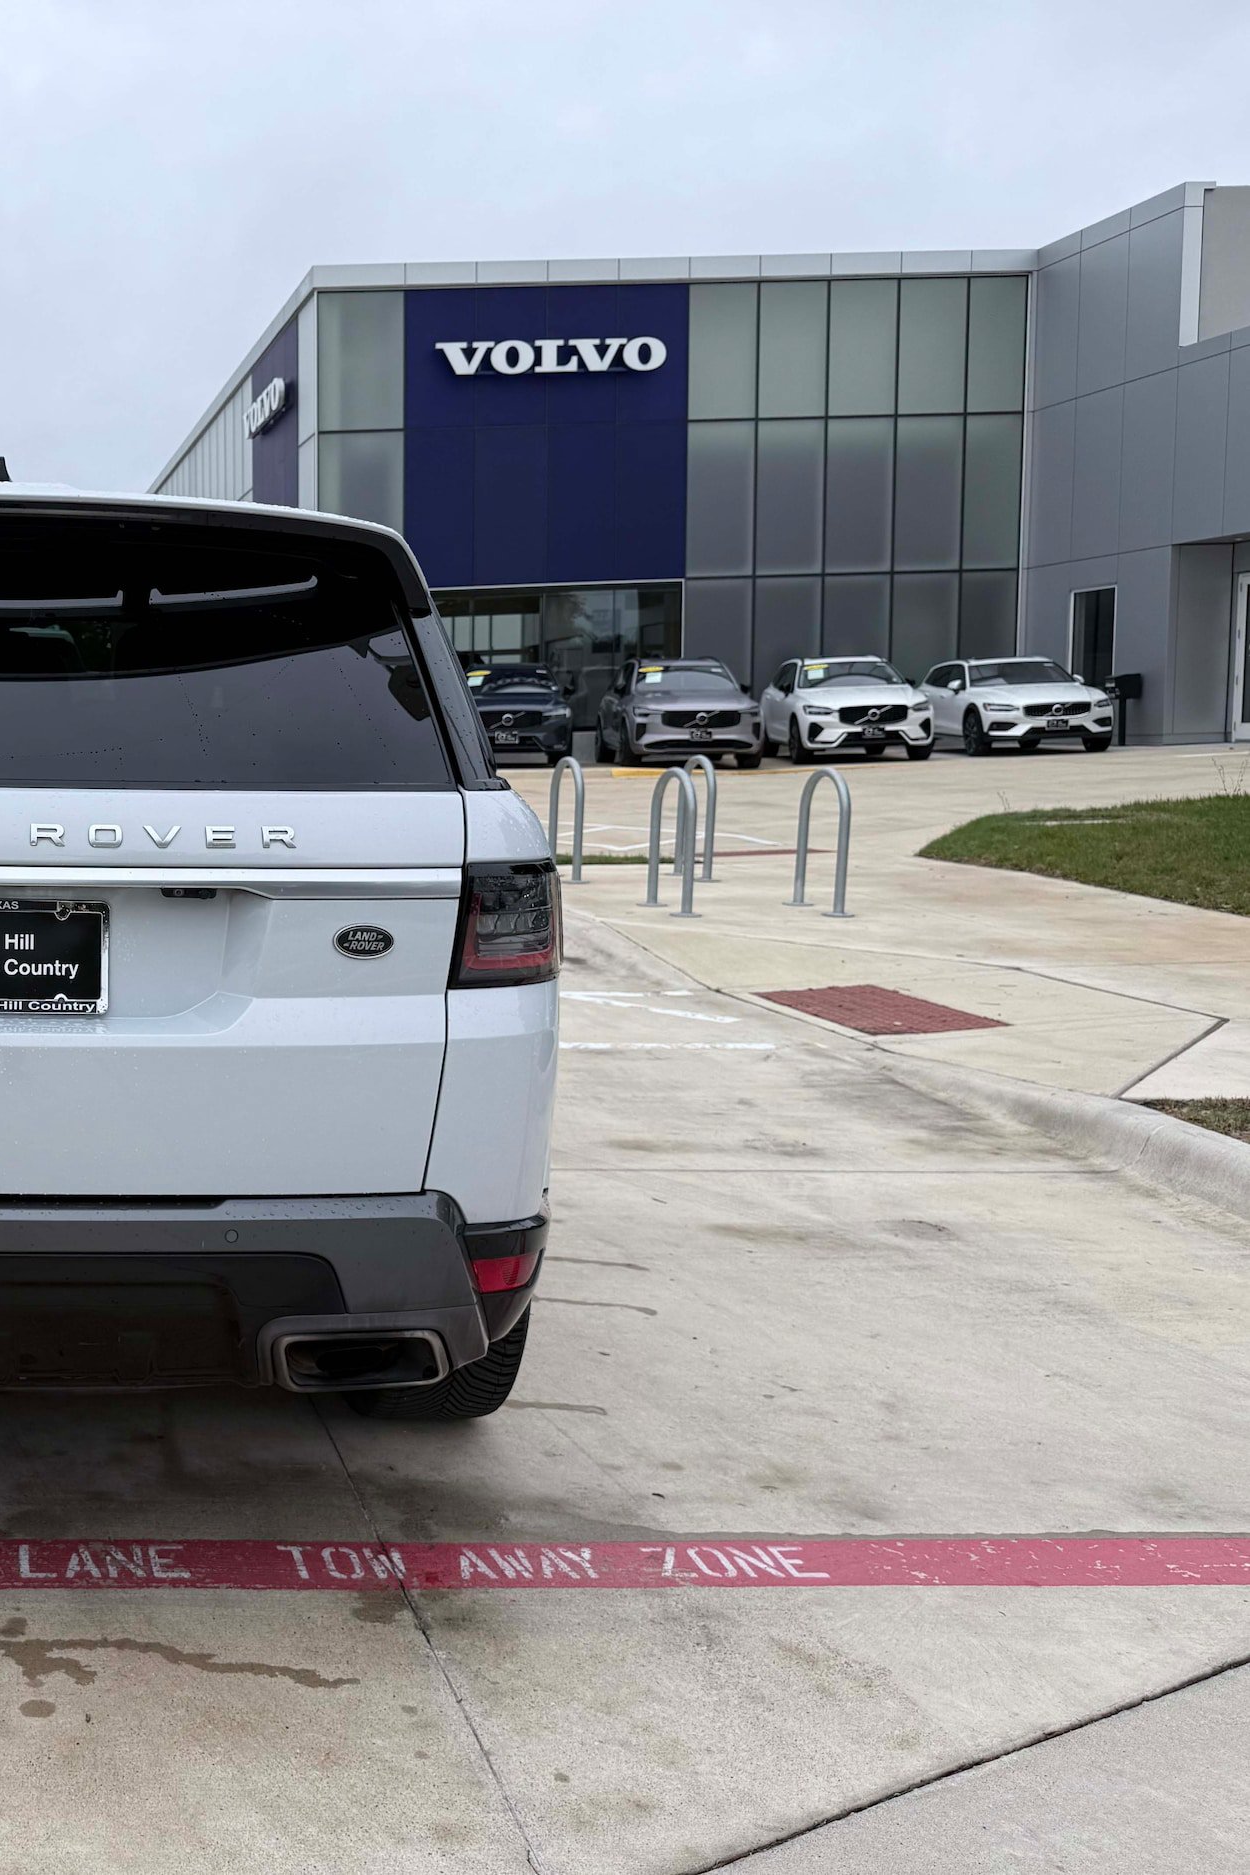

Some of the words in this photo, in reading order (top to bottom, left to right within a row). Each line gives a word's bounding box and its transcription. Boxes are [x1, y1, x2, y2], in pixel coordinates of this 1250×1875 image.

[435, 336, 667, 375] VOLVO
[243, 377, 285, 439] VOLVO
[30, 823, 297, 849] ROVER
[4, 933, 35, 950] Hill
[348, 931, 377, 941] LAND
[349, 941, 385, 950] ROVER
[3, 958, 79, 979] Country
[27, 1000, 96, 1012] Country
[18, 1544, 192, 1579] LANE
[277, 1545, 406, 1580] TOW
[459, 1547, 599, 1580] AWAY
[639, 1546, 831, 1578] ZONE
